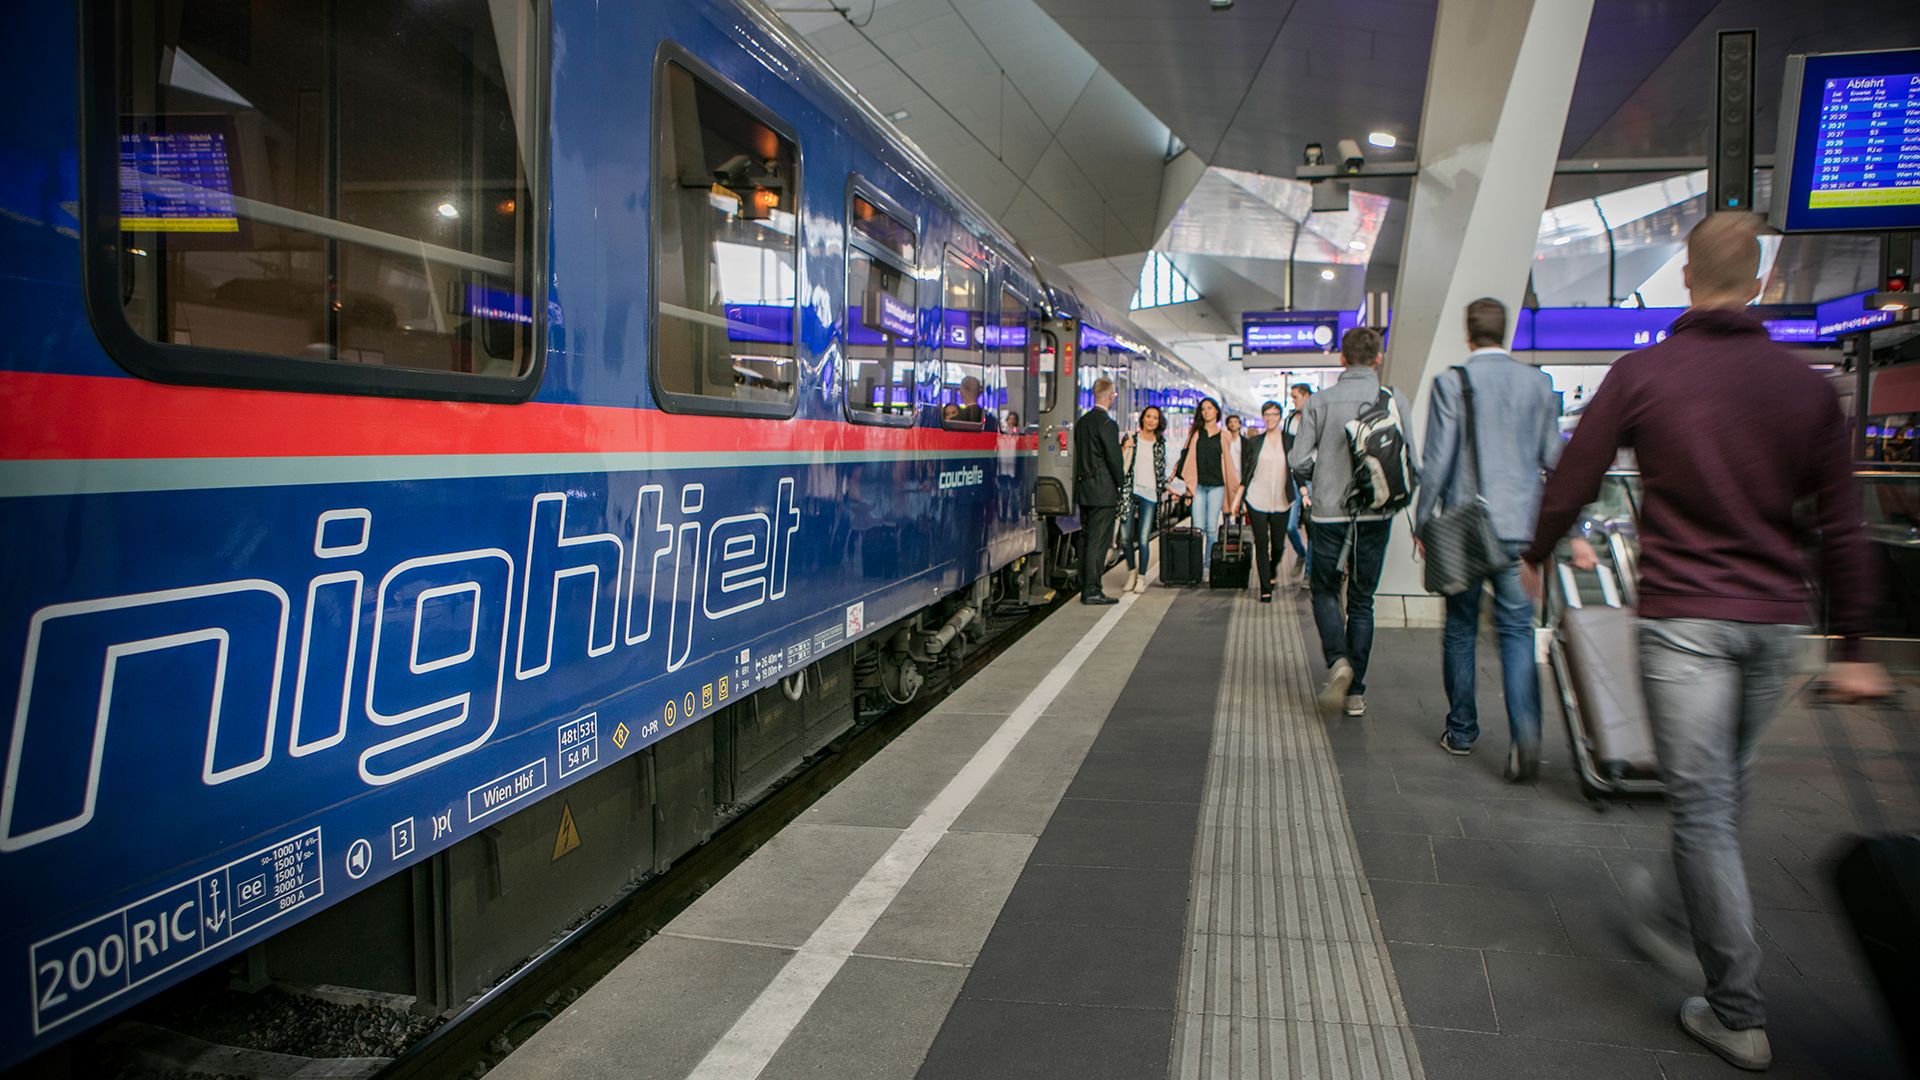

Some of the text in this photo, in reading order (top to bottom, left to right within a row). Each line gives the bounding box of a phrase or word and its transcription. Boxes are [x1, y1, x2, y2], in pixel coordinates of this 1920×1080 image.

[1846, 78, 1884, 89] Abfahrt
[939, 465, 983, 490] couchette
[0, 477, 801, 853] nightjet
[483, 770, 535, 808] Wien Hbf
[399, 829, 407, 848] 3
[272, 843, 294, 861] 1000
[274, 855, 295, 872] 1500
[274, 866, 296, 884] 1500
[241, 878, 263, 900] ee
[274, 878, 296, 897] 3000
[280, 889, 305, 910] 800 A
[39, 900, 196, 1011] 200 RIC
